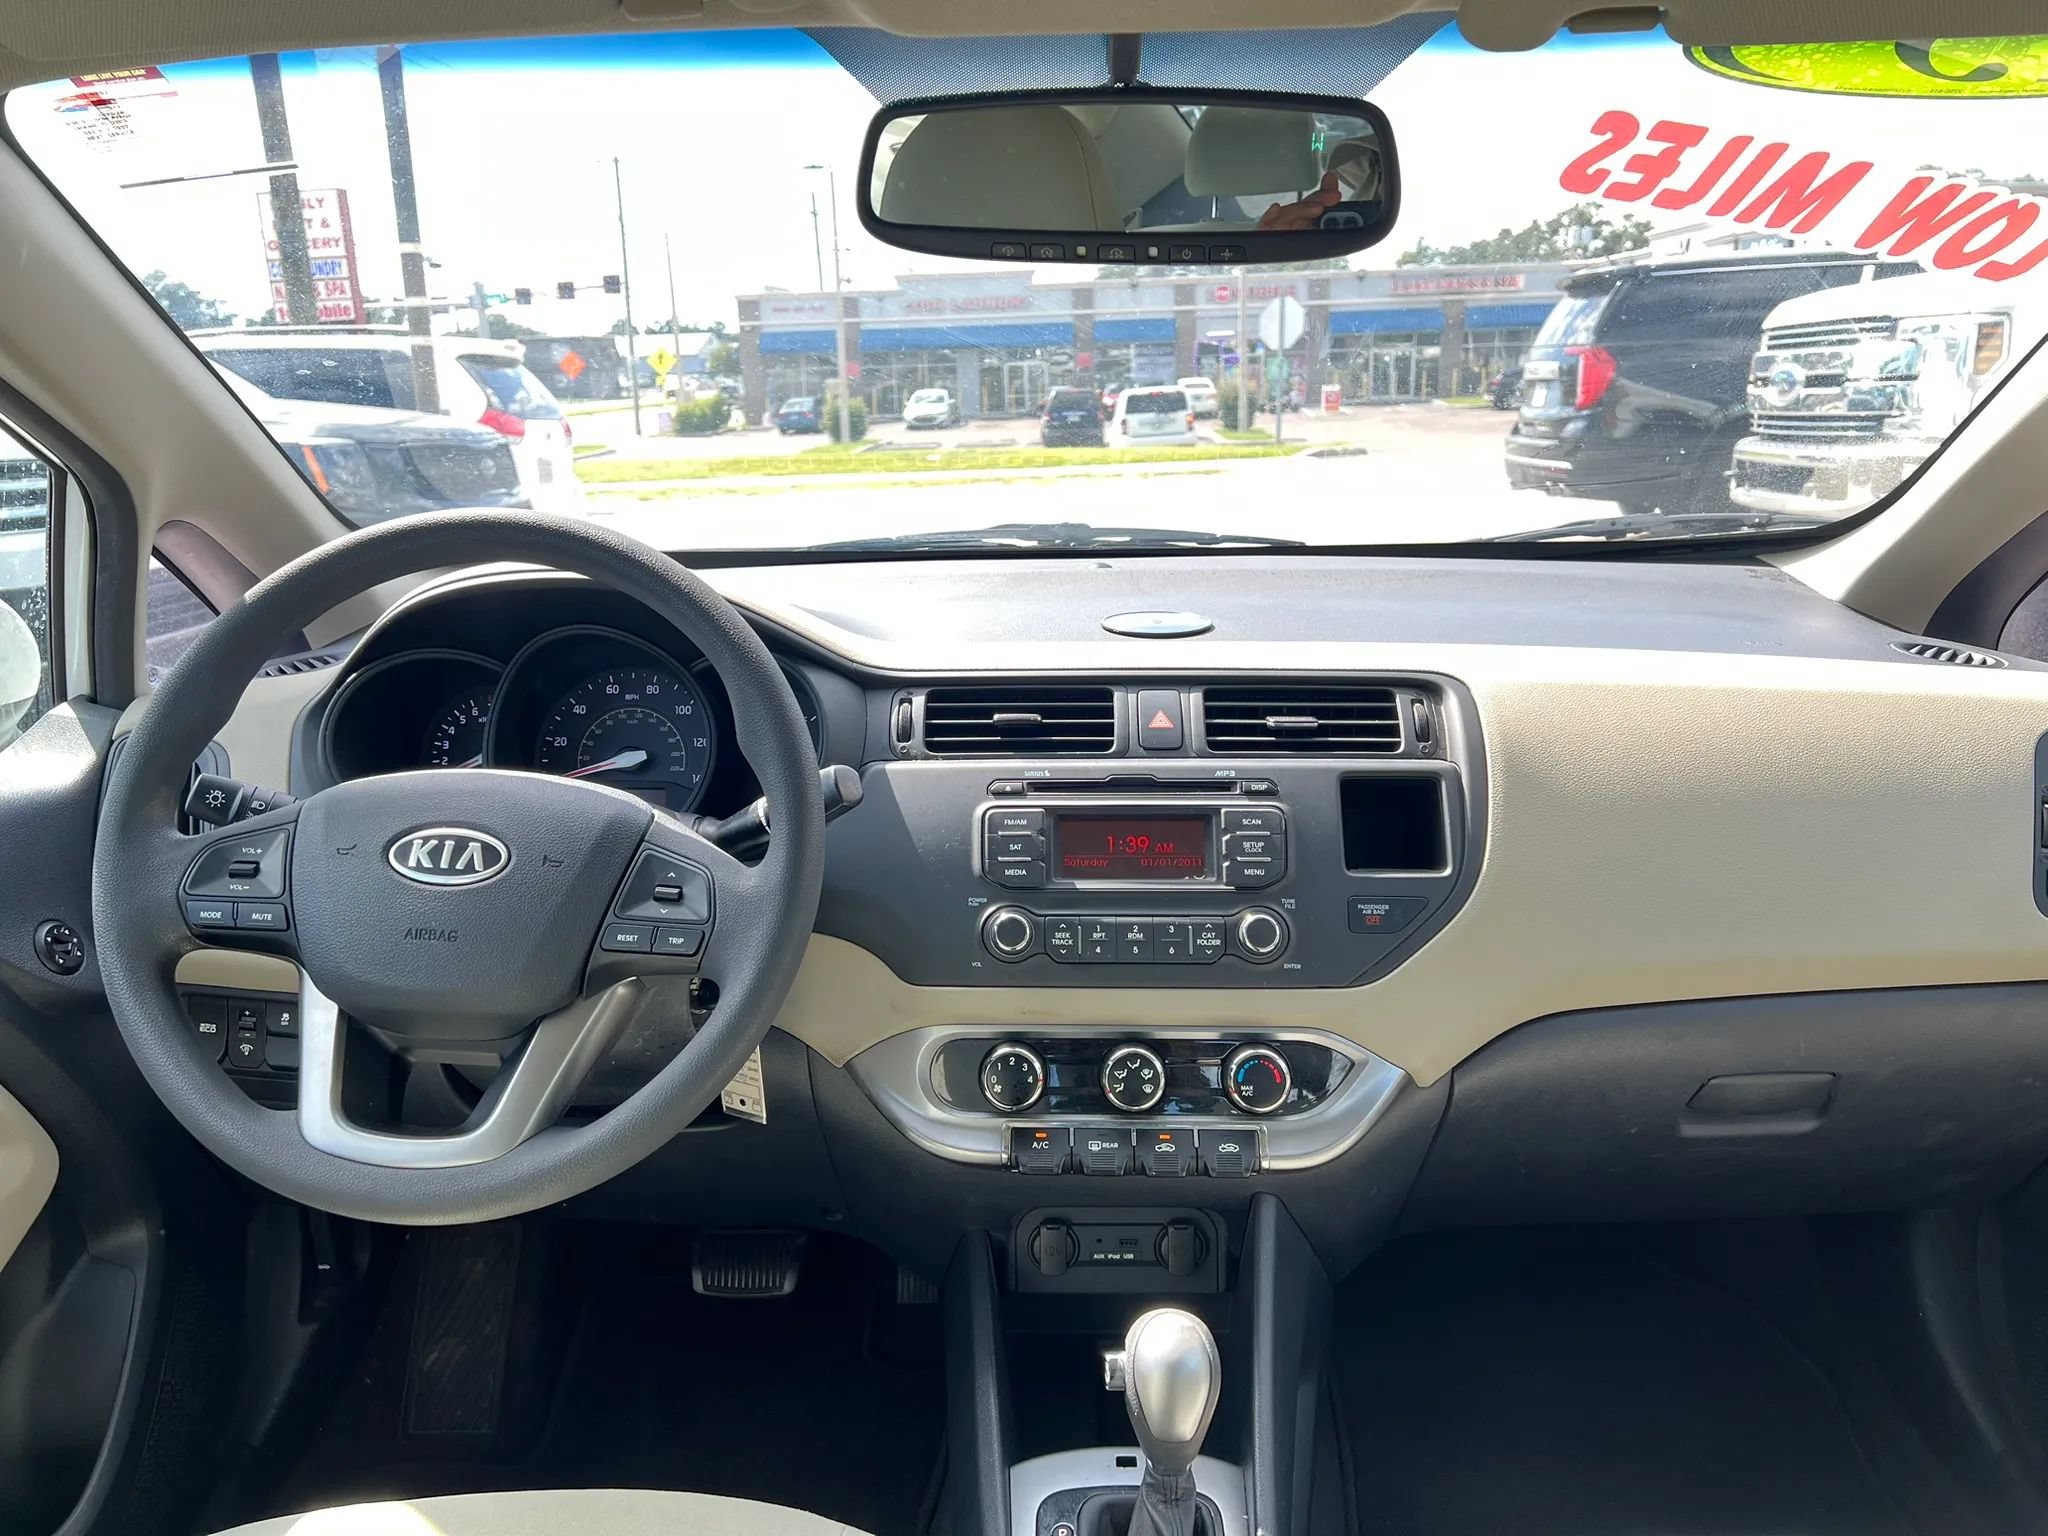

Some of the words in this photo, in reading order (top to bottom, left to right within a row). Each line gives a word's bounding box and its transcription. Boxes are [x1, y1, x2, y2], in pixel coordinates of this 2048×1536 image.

[606, 684, 619, 694] 60
[646, 684, 659, 694] 80
[472, 707, 478, 716] 6
[573, 705, 586, 714] 40
[675, 705, 691, 714] 100
[460, 715, 466, 724] 5
[448, 726, 455, 735] 4
[442, 740, 449, 749] 3
[554, 737, 567, 746] 20
[441, 757, 448, 765] 2
[1107, 836, 1149, 854] 1:39
[1155, 843, 1173, 852] AM
[408, 839, 484, 871] KIA
[1064, 858, 1108, 868] Saturday
[200, 911, 222, 919] MODE
[404, 927, 458, 942] AIRBAG
[617, 934, 638, 942] RESET
[1009, 1057, 1015, 1065] 2
[1022, 1063, 1028, 1071] 3
[990, 1075, 996, 1083] 0
[1027, 1075, 1033, 1083] 4
[1032, 1141, 1049, 1149] A/C
